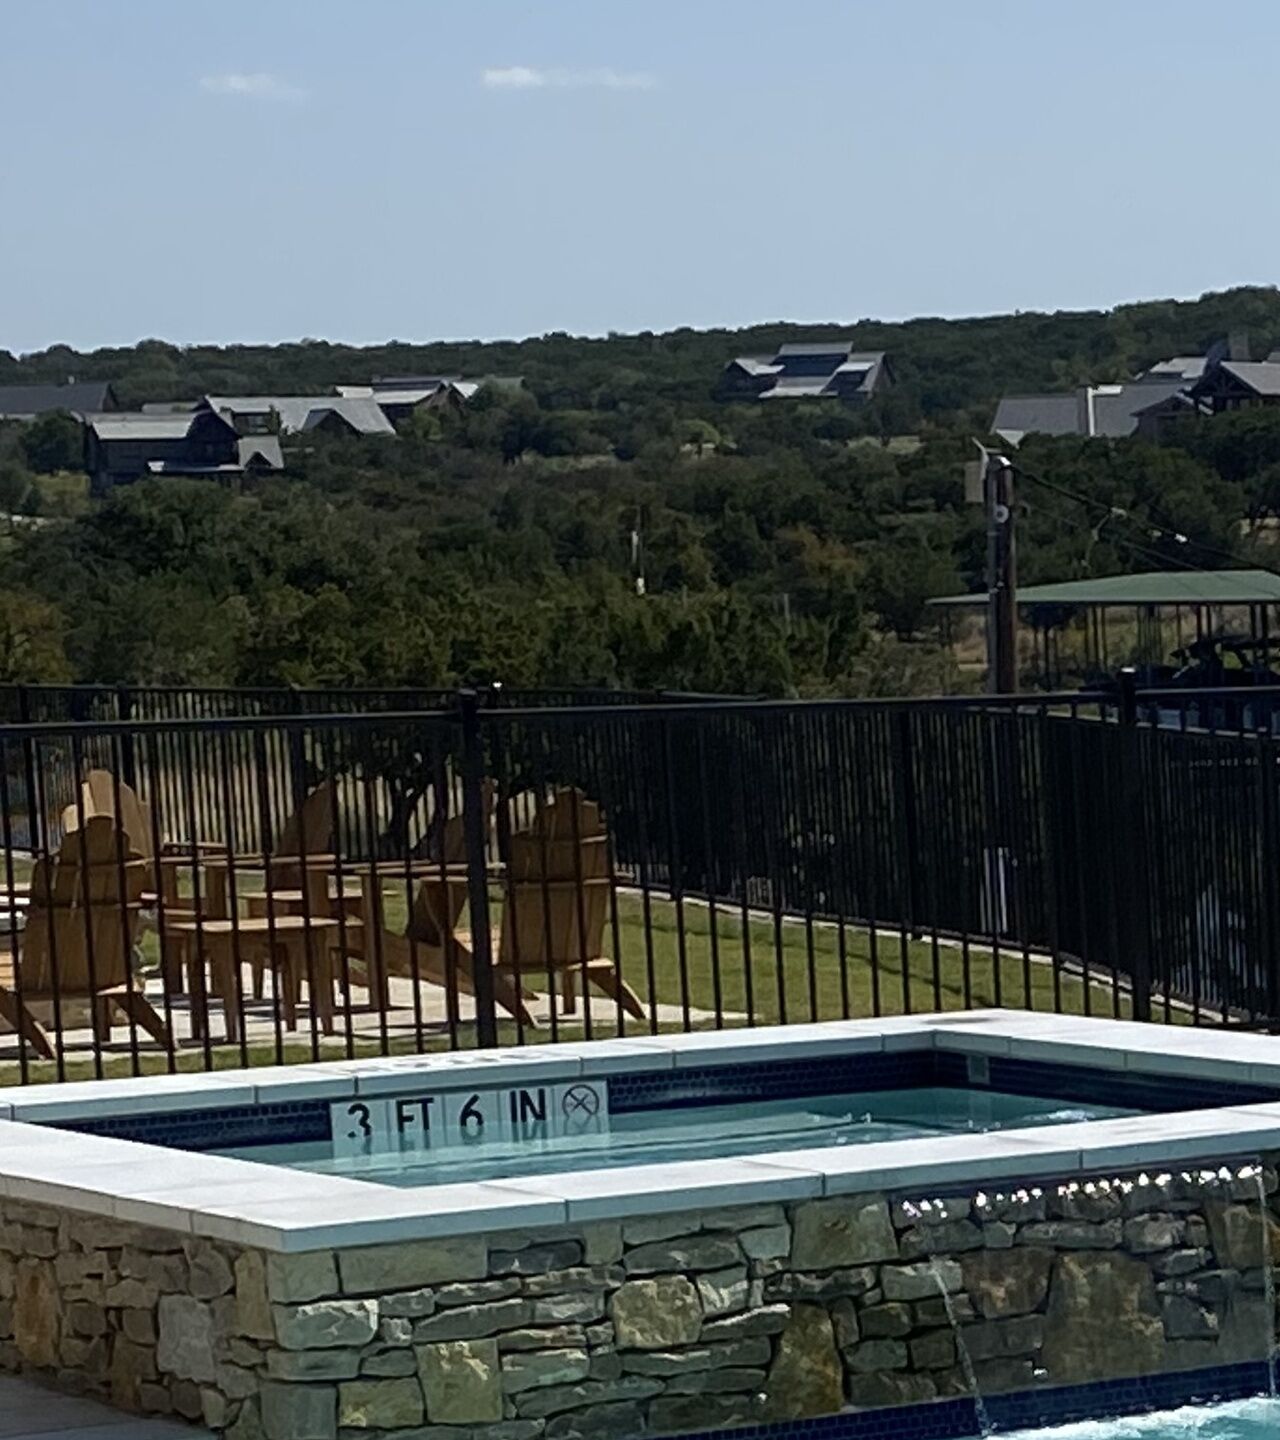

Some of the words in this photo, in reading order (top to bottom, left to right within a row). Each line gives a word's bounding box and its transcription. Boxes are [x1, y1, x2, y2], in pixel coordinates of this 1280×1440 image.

[347, 1102, 371, 1137] 3
[396, 1097, 434, 1133] FT
[460, 1094, 484, 1127] 6
[510, 1088, 547, 1123] IN
